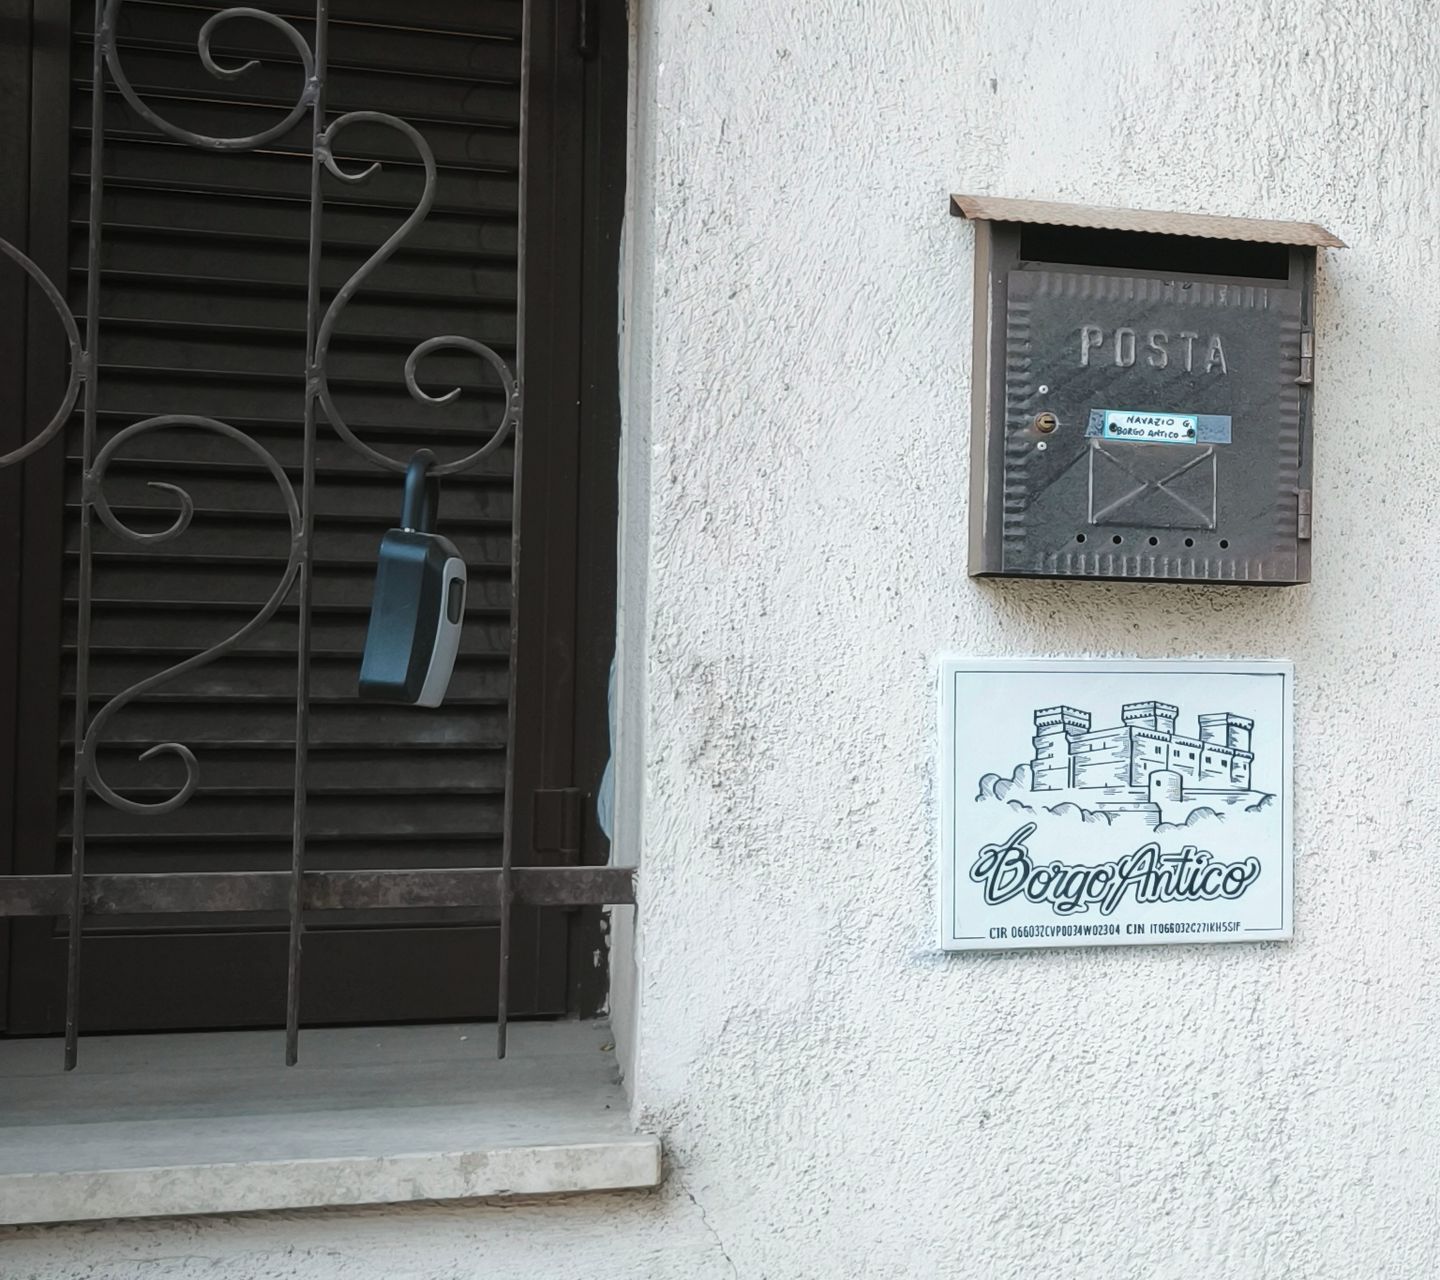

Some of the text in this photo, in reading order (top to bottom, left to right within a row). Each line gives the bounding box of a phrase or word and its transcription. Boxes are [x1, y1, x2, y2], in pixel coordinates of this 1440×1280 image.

[1079, 325, 1228, 375] POSTA
[1126, 416, 1175, 428] NAVAZIO
[1116, 426, 1179, 439] BORGO ANTICO
[970, 822, 1261, 916] Borgo Antico
[989, 926, 1008, 939] CIR
[1126, 923, 1145, 935] CIN
